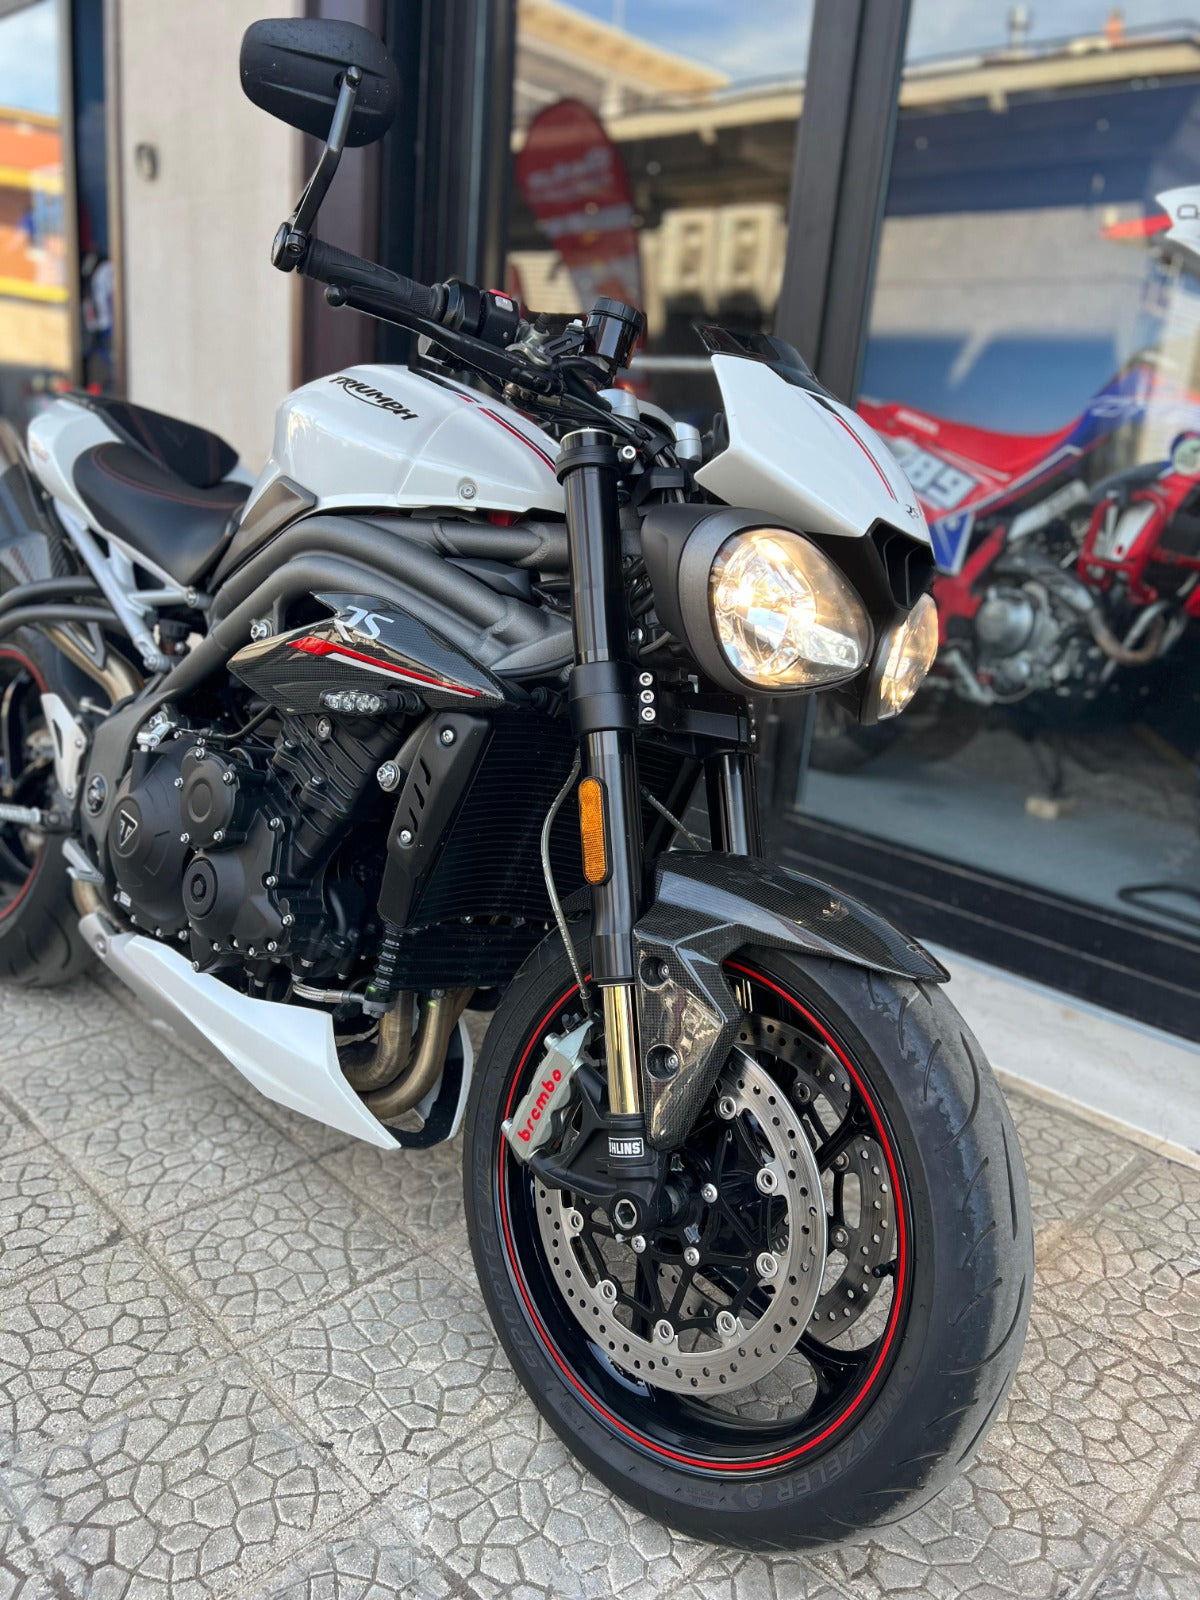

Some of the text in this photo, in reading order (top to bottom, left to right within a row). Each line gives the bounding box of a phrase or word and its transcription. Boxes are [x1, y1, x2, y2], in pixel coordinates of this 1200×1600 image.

[329, 376, 419, 420] TRIUMPH
[334, 605, 395, 643] RS
[517, 1068, 562, 1142] brembo
[478, 1208, 547, 1371] SPORTEC
[776, 1386, 904, 1502] METZELER
